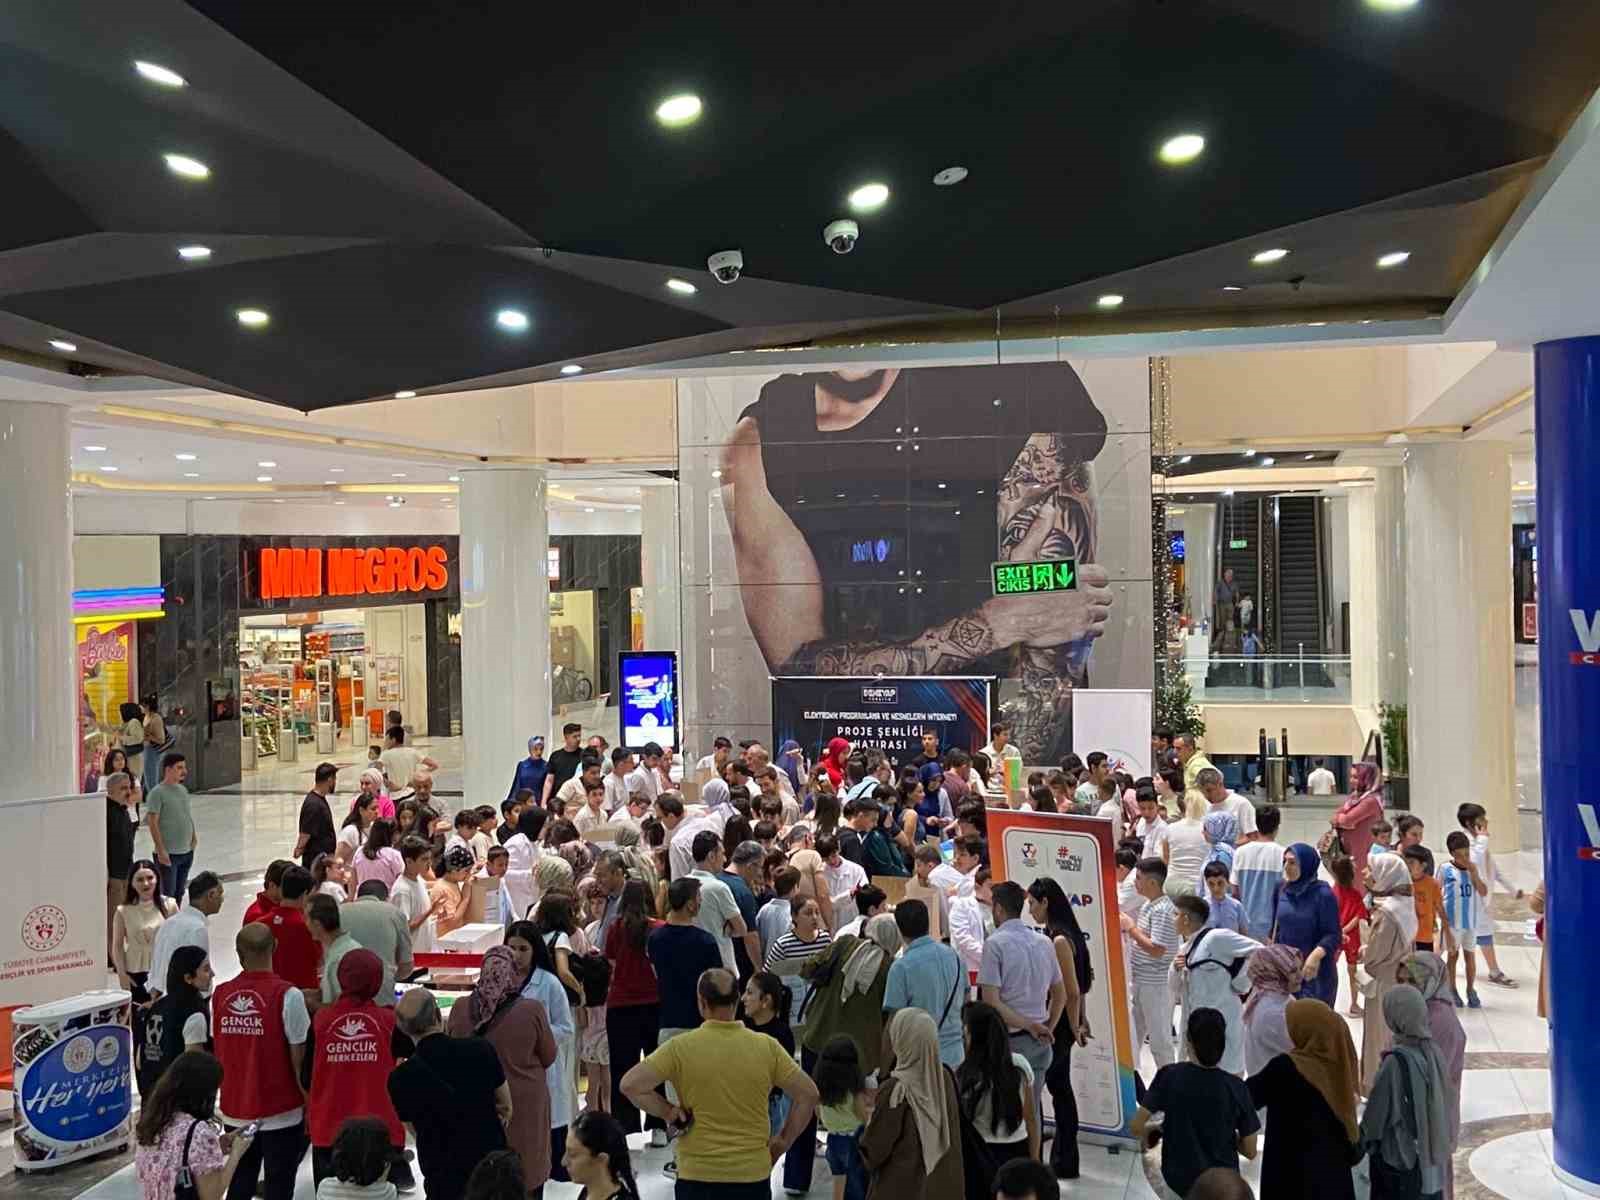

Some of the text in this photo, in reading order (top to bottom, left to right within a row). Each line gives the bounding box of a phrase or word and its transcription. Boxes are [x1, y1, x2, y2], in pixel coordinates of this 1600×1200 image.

[261, 548, 322, 600] MM
[996, 566, 1029, 580] EXIT
[837, 726, 873, 737] PROJE
[1460, 884, 1472, 897] 10
